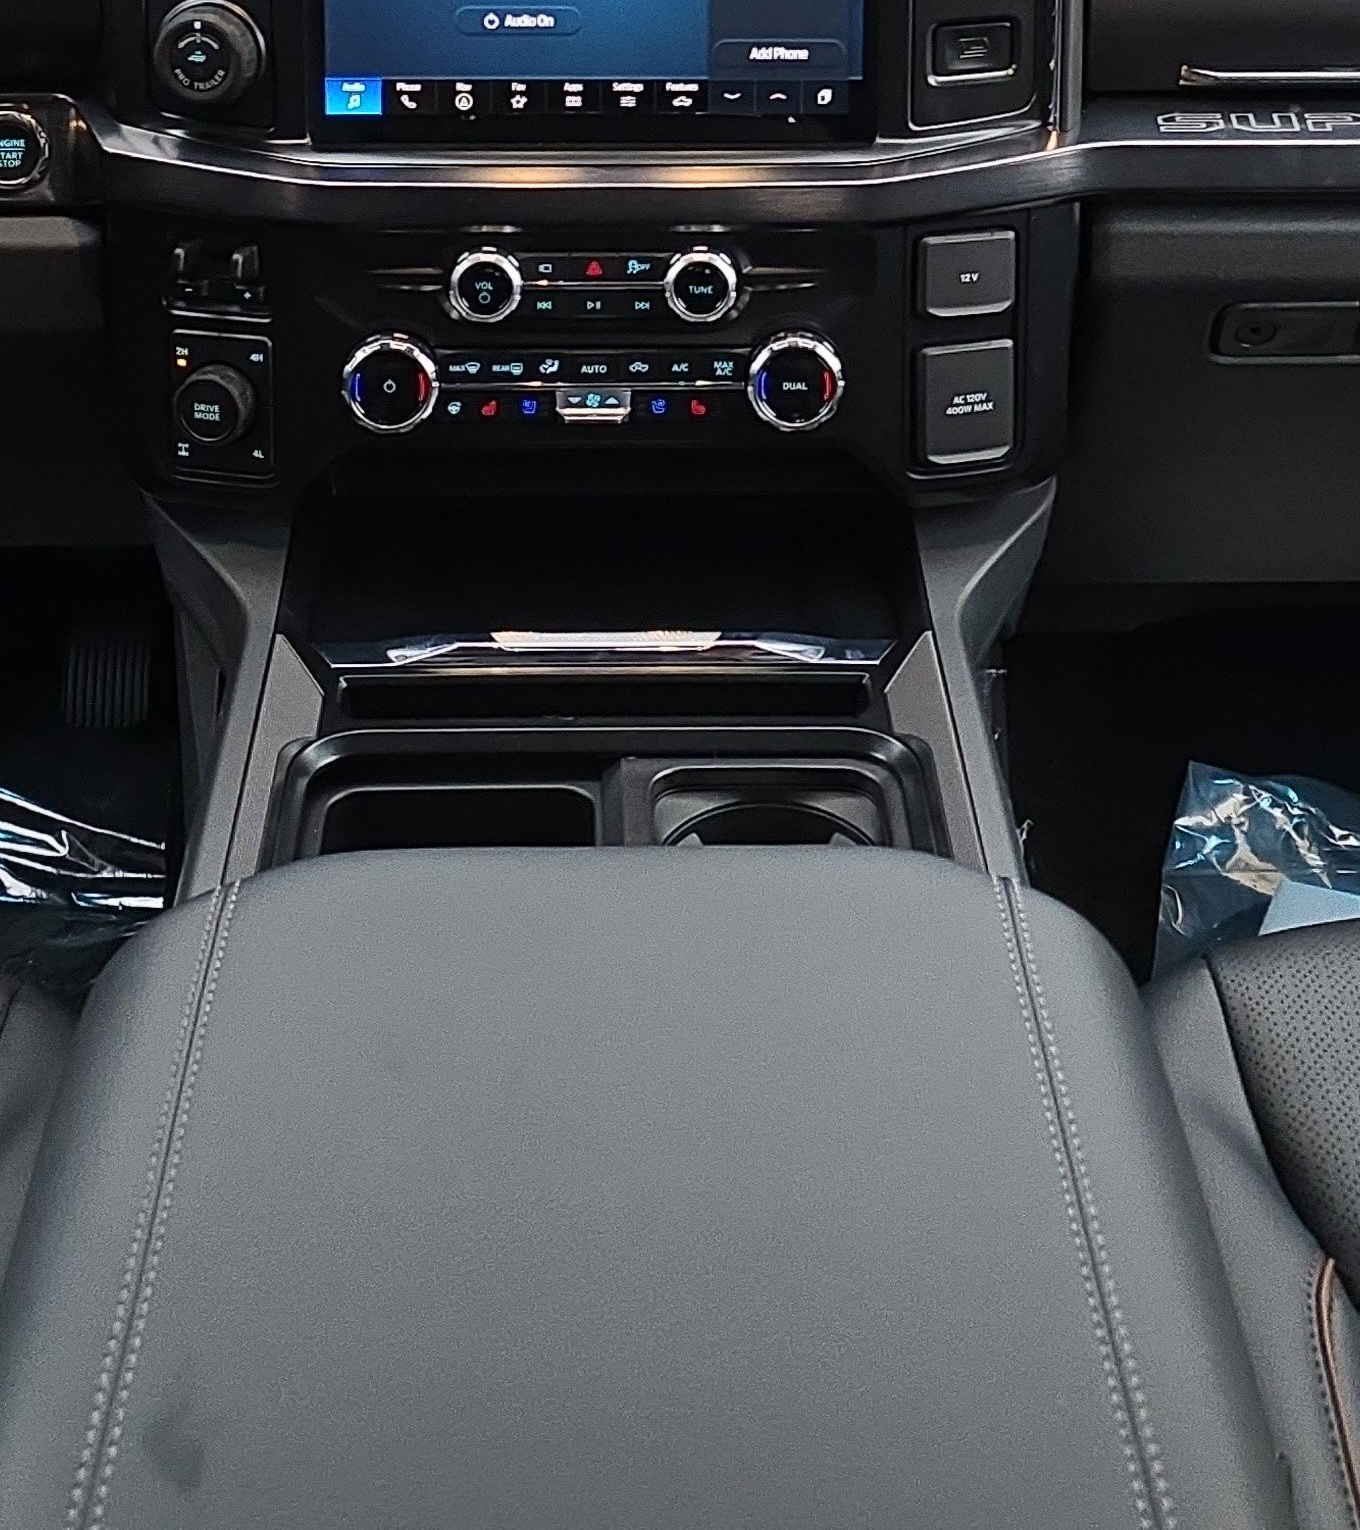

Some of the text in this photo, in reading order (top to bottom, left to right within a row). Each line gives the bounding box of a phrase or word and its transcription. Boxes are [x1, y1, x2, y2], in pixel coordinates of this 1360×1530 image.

[505, 15, 554, 27] Audio On
[749, 46, 809, 60] Add Phone
[174, 69, 226, 90] PRO TRAILER
[612, 82, 644, 92] Settings
[666, 82, 699, 91] Features
[475, 282, 493, 290] VOL
[689, 286, 713, 294] TUNE
[176, 347, 189, 355] 2H
[581, 365, 607, 374] AUTO
[672, 363, 689, 372] A/C
[714, 361, 734, 370] MAX
[715, 368, 732, 376] A/C
[953, 393, 987, 405] AC 120V
[194, 403, 220, 413] DRIVE
[946, 401, 994, 416] 400W MAX
[194, 412, 220, 421] MODE
[252, 450, 265, 458] 4L
